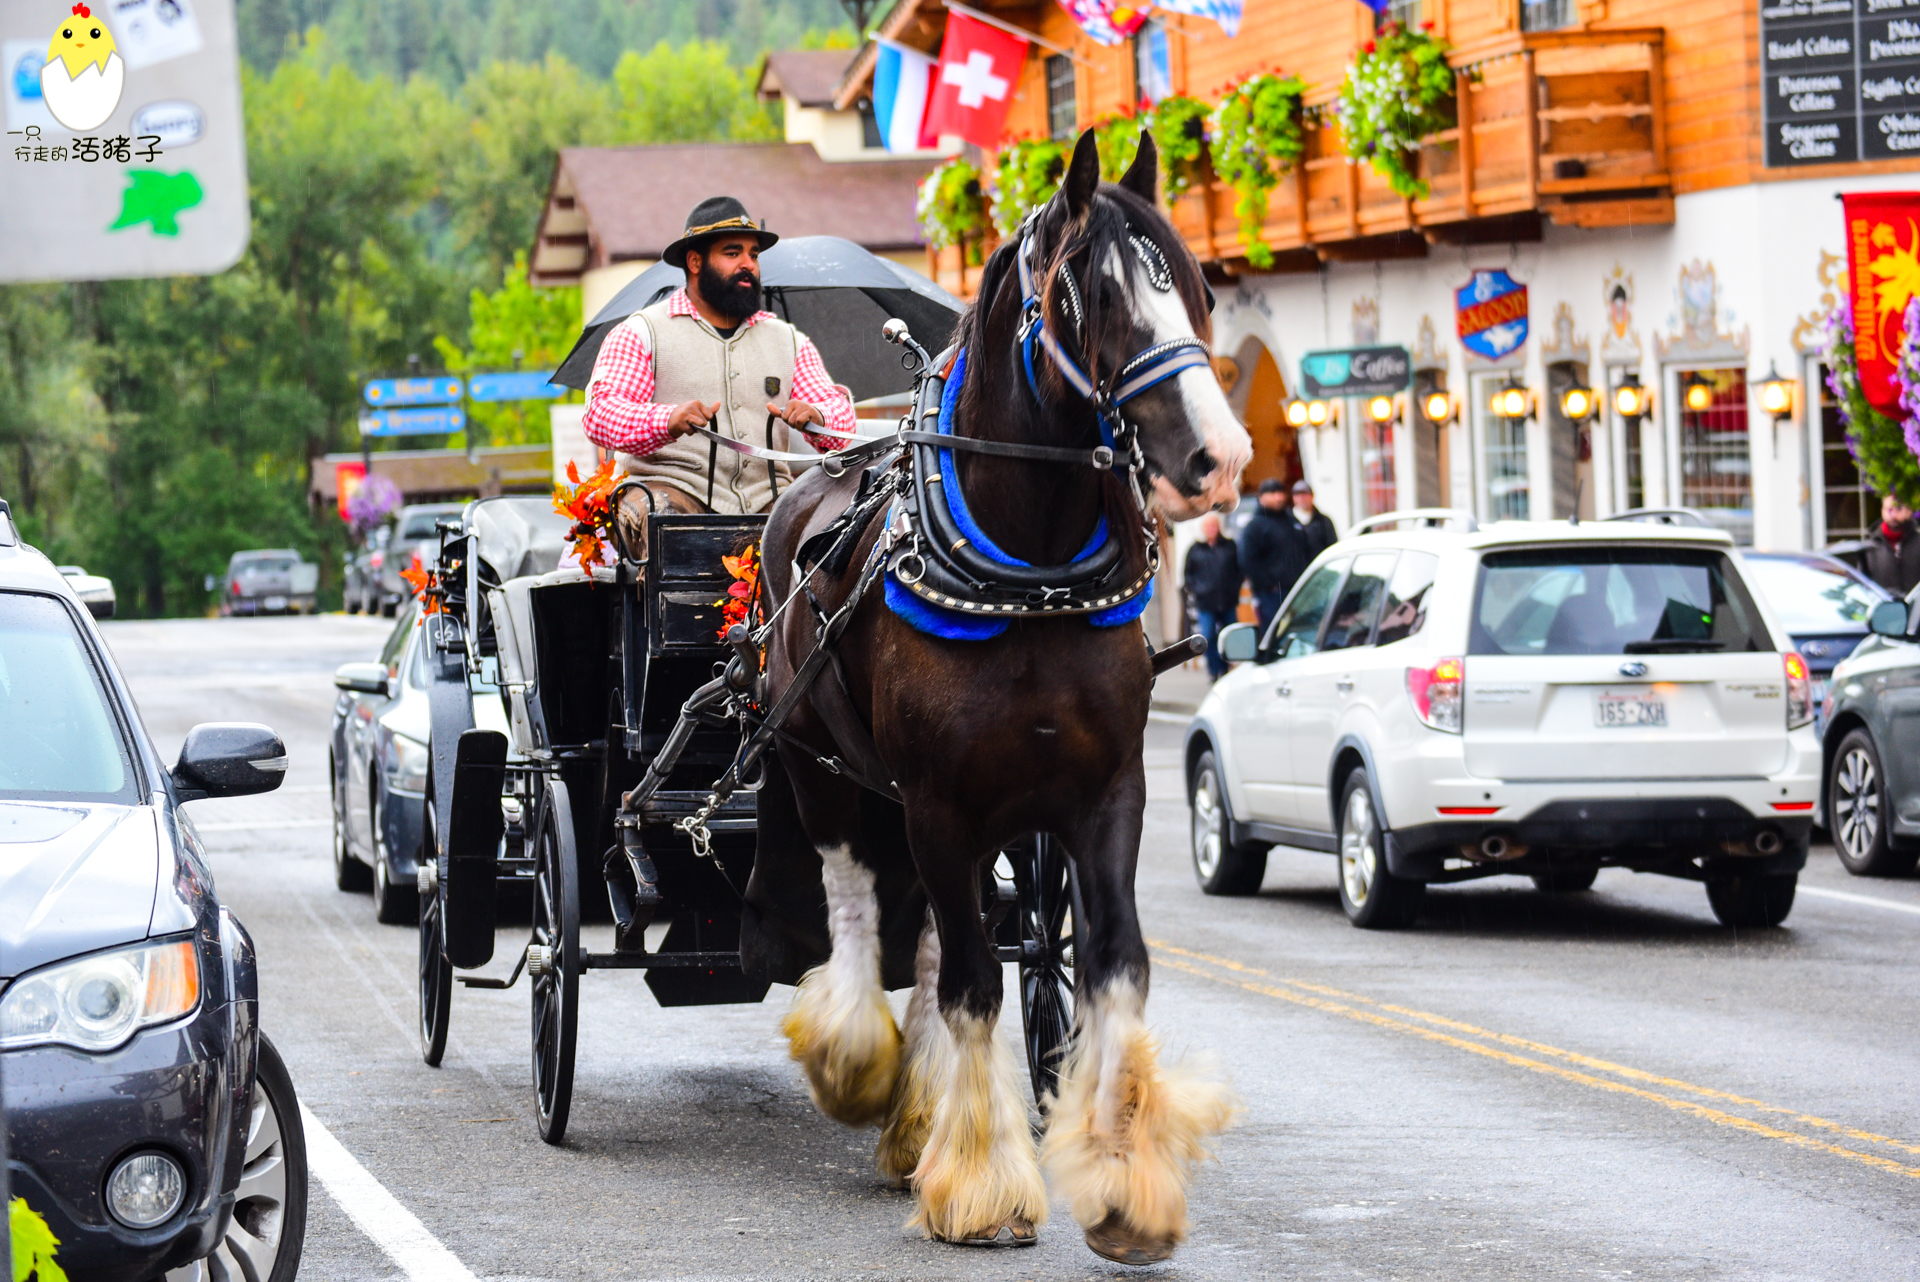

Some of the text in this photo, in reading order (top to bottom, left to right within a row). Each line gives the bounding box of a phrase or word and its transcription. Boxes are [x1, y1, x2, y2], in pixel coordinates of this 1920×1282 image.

[1805, 35, 1850, 56] Cellars
[1779, 75, 1842, 97] Patterson
[1789, 92, 1836, 112] Cellars
[1789, 140, 1836, 159] Cellars
[1458, 290, 1527, 336] SALOON
[1350, 353, 1406, 381] Coffee
